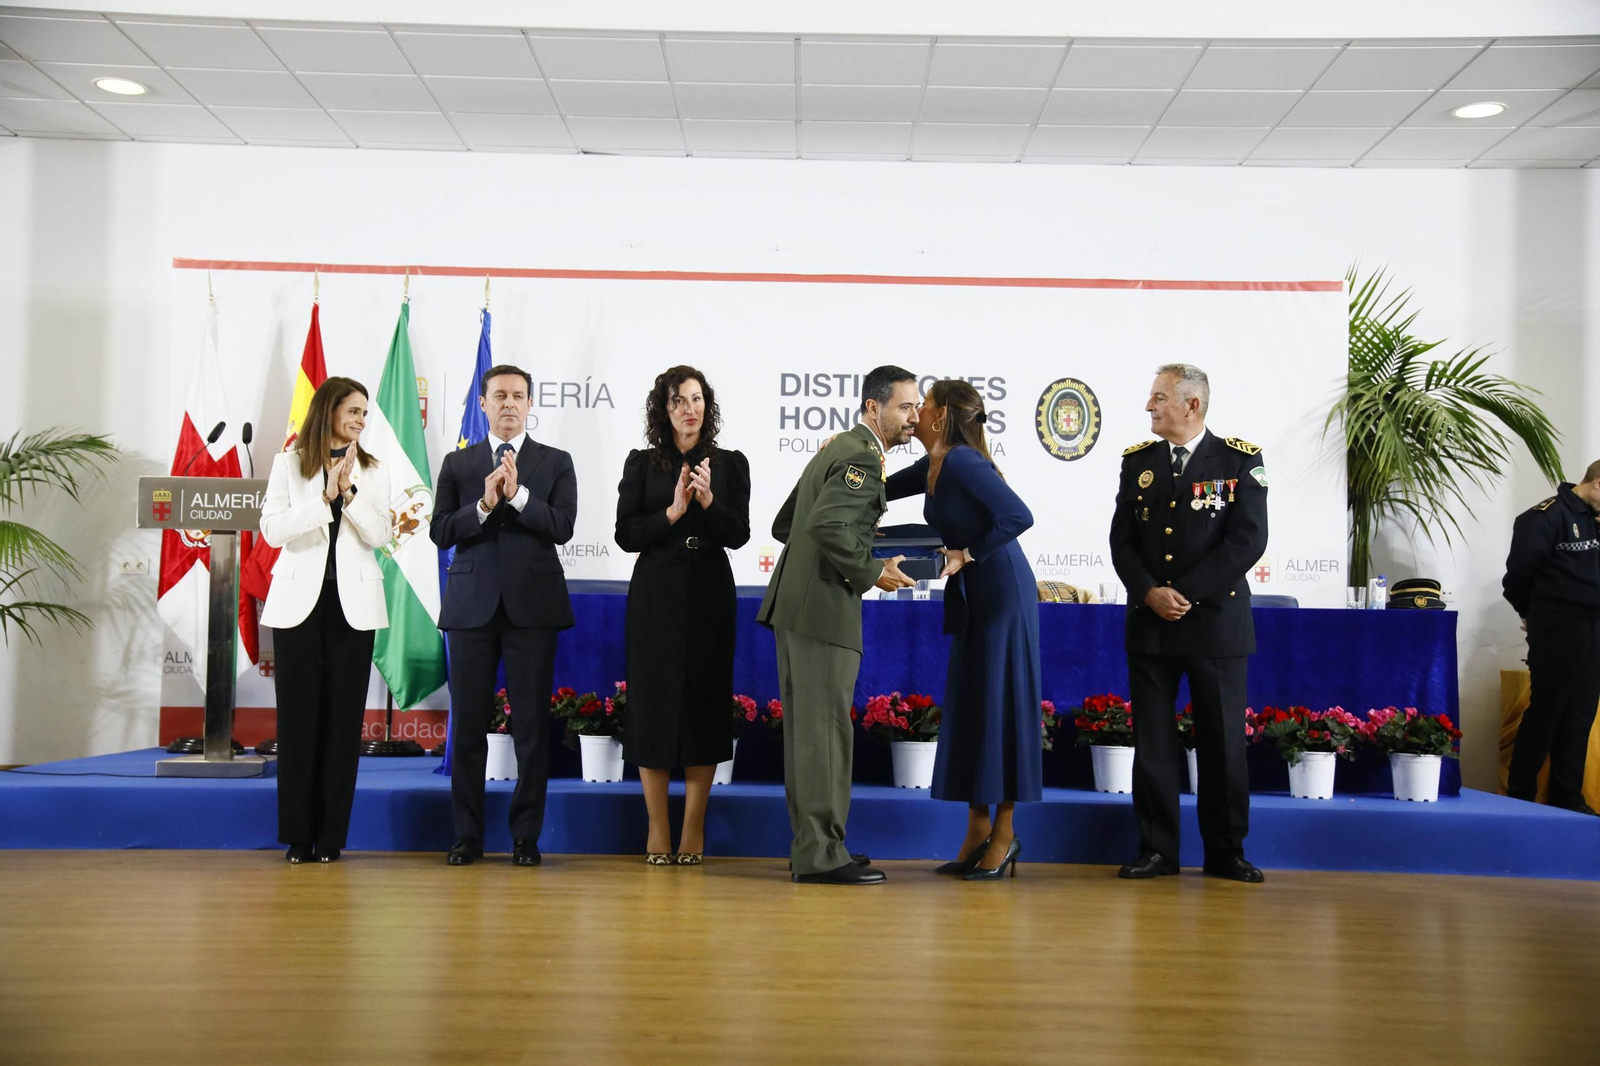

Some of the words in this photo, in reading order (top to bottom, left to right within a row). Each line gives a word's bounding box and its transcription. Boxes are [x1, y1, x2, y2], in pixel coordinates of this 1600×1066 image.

[190, 509, 232, 520] CIUDAD
[558, 542, 610, 557] MERÍA
[1036, 552, 1104, 567] ALMERÍA
[1285, 559, 1339, 573] ALMER
[1035, 567, 1071, 577] CIUDAD
[1285, 573, 1321, 583] CIUDAD
[162, 665, 193, 675] CIUDA
